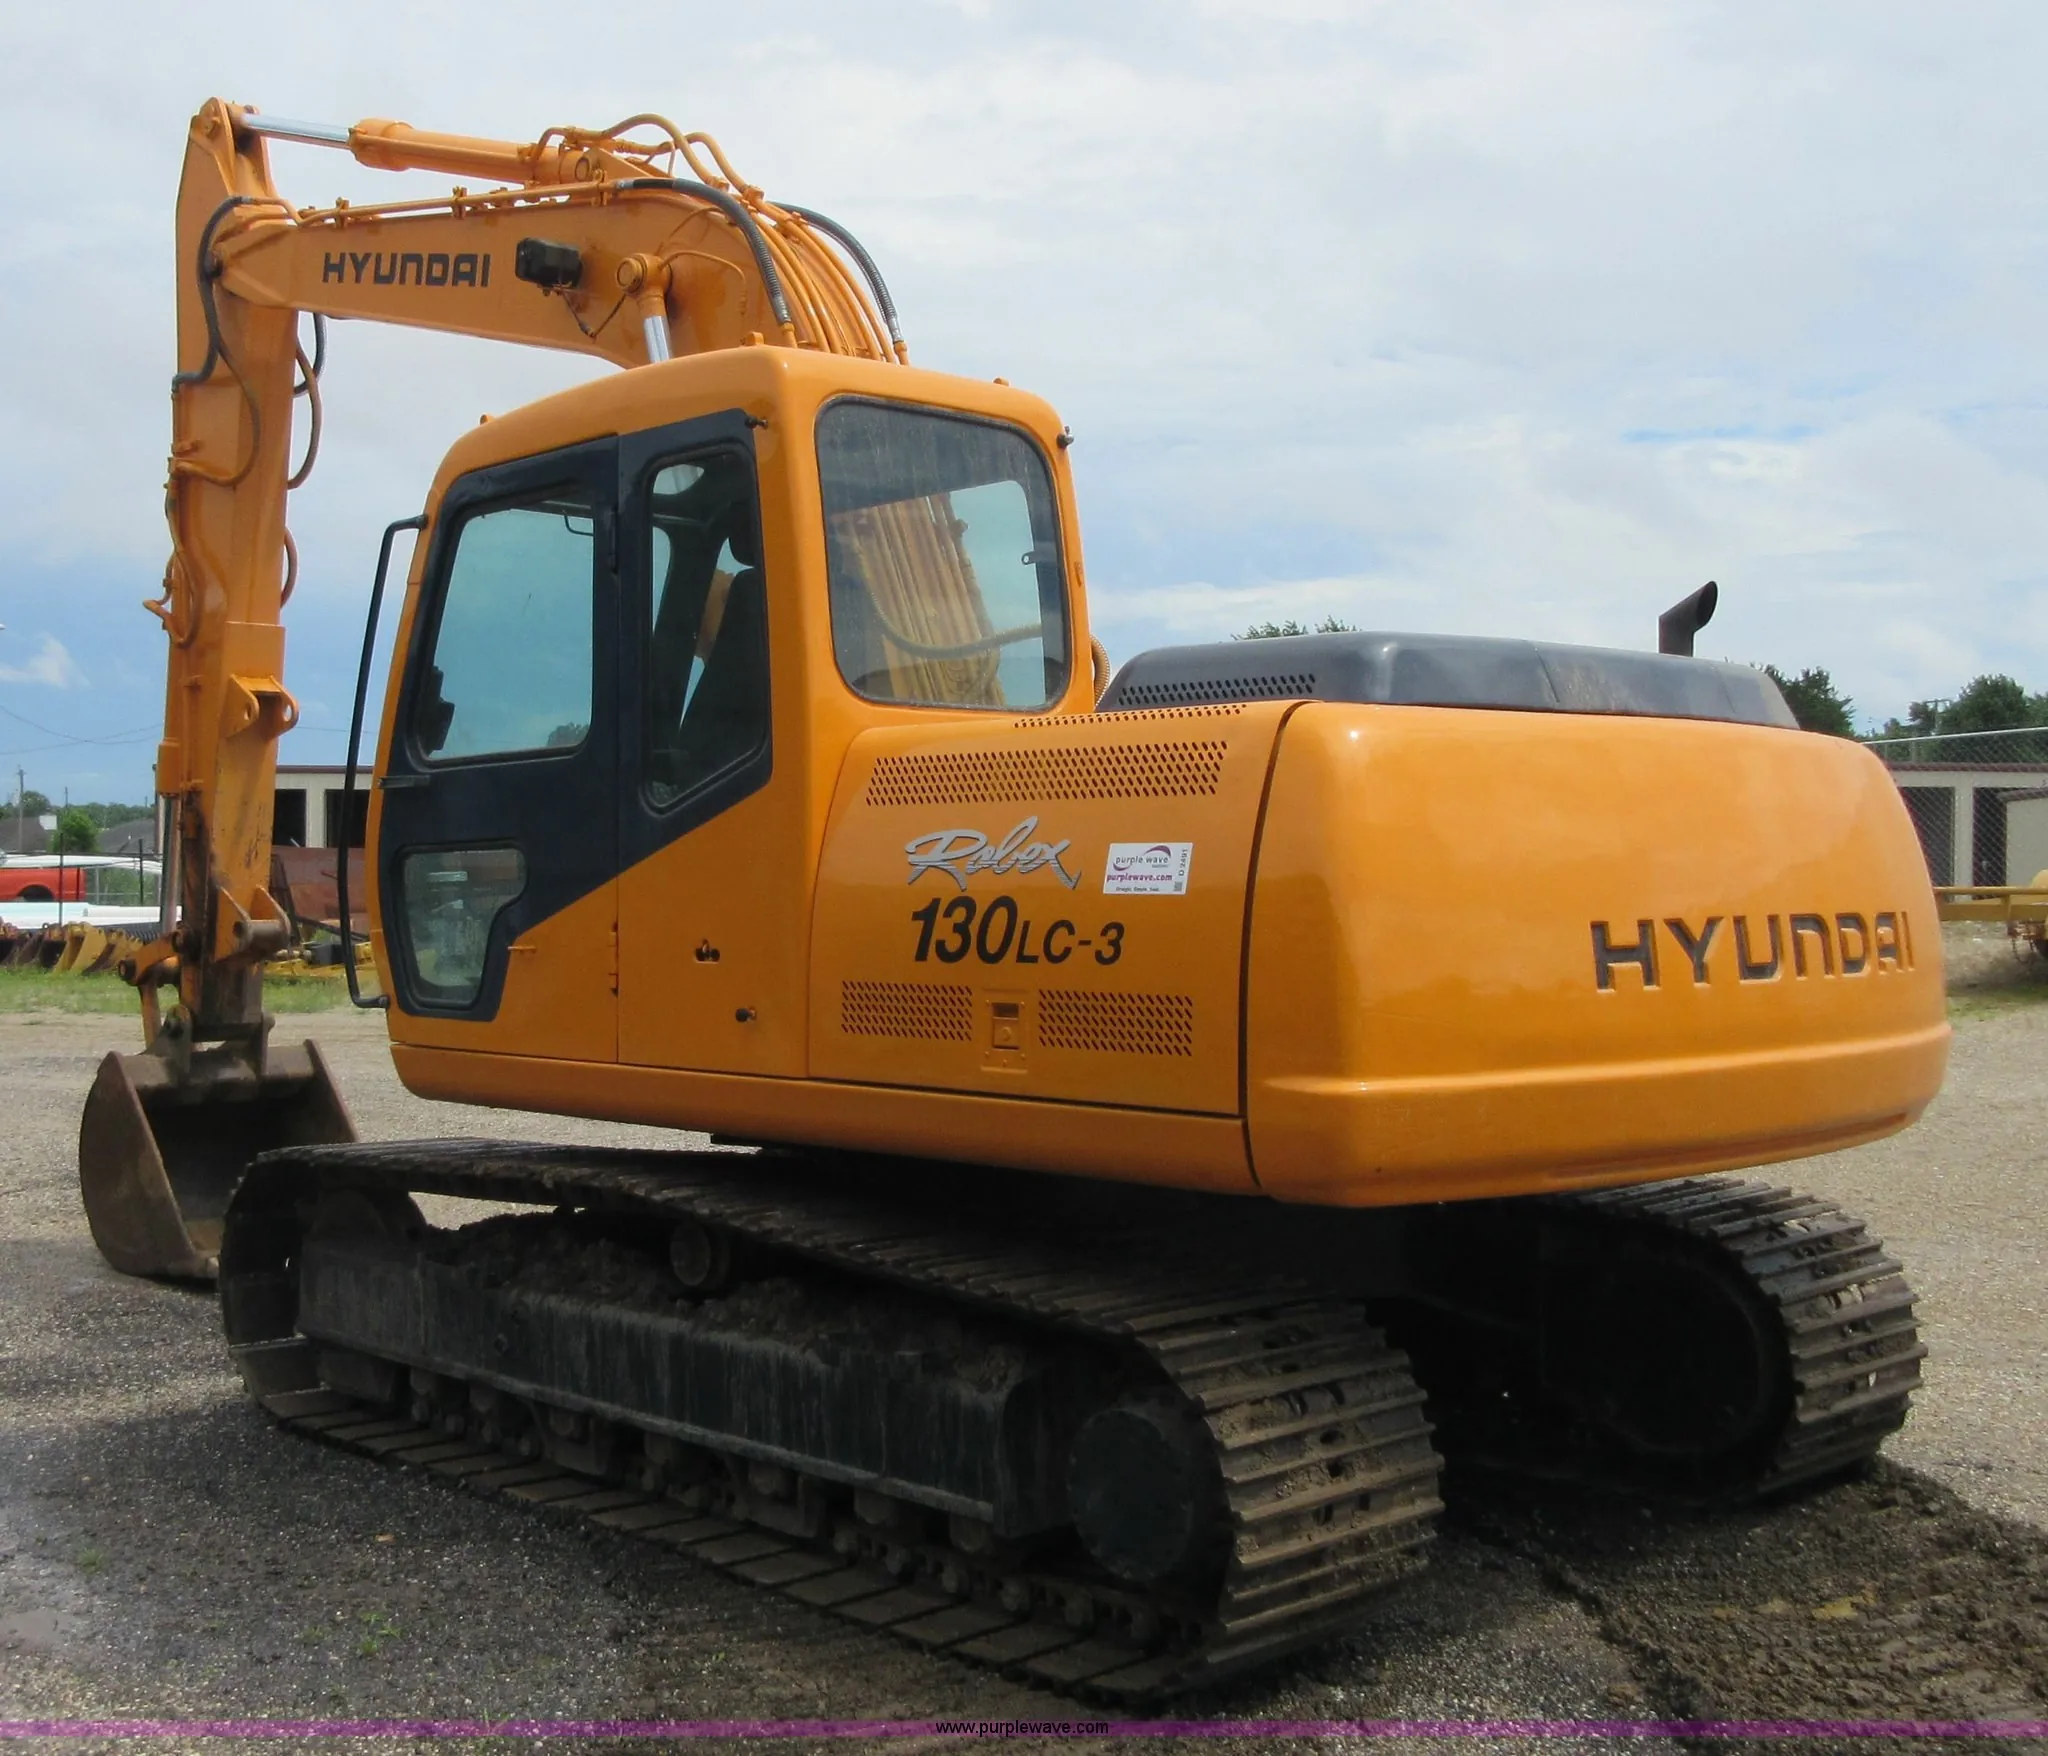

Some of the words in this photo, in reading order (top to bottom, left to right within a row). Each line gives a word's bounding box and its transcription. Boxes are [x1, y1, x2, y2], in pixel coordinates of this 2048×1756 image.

[322, 252, 491, 287] HYUNDAI
[1106, 872, 1173, 883] purplewave.com
[1115, 855, 1144, 866] purple
[1145, 856, 1169, 864] wave
[911, 896, 1125, 965] 130LC-3
[1590, 912, 1916, 993] HYUNDAI
